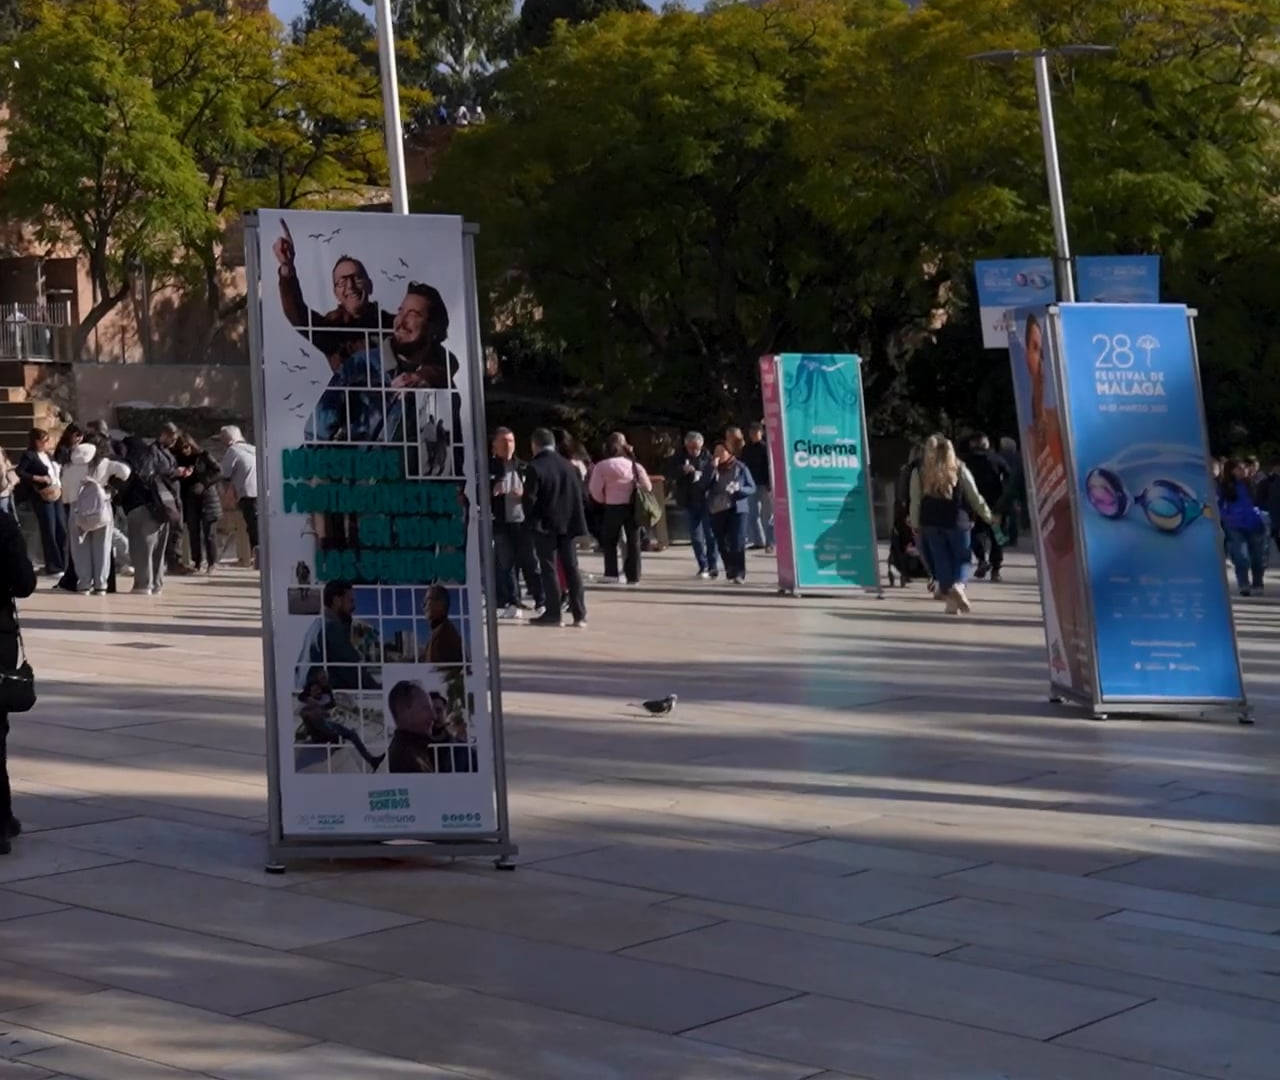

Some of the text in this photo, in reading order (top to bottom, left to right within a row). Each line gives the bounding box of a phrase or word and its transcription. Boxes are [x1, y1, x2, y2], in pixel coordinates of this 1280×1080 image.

[1092, 334, 1135, 368] 28
[1095, 371, 1146, 381] FESTIVAL
[794, 439, 857, 455] Cinema
[793, 451, 859, 468] Cocina
